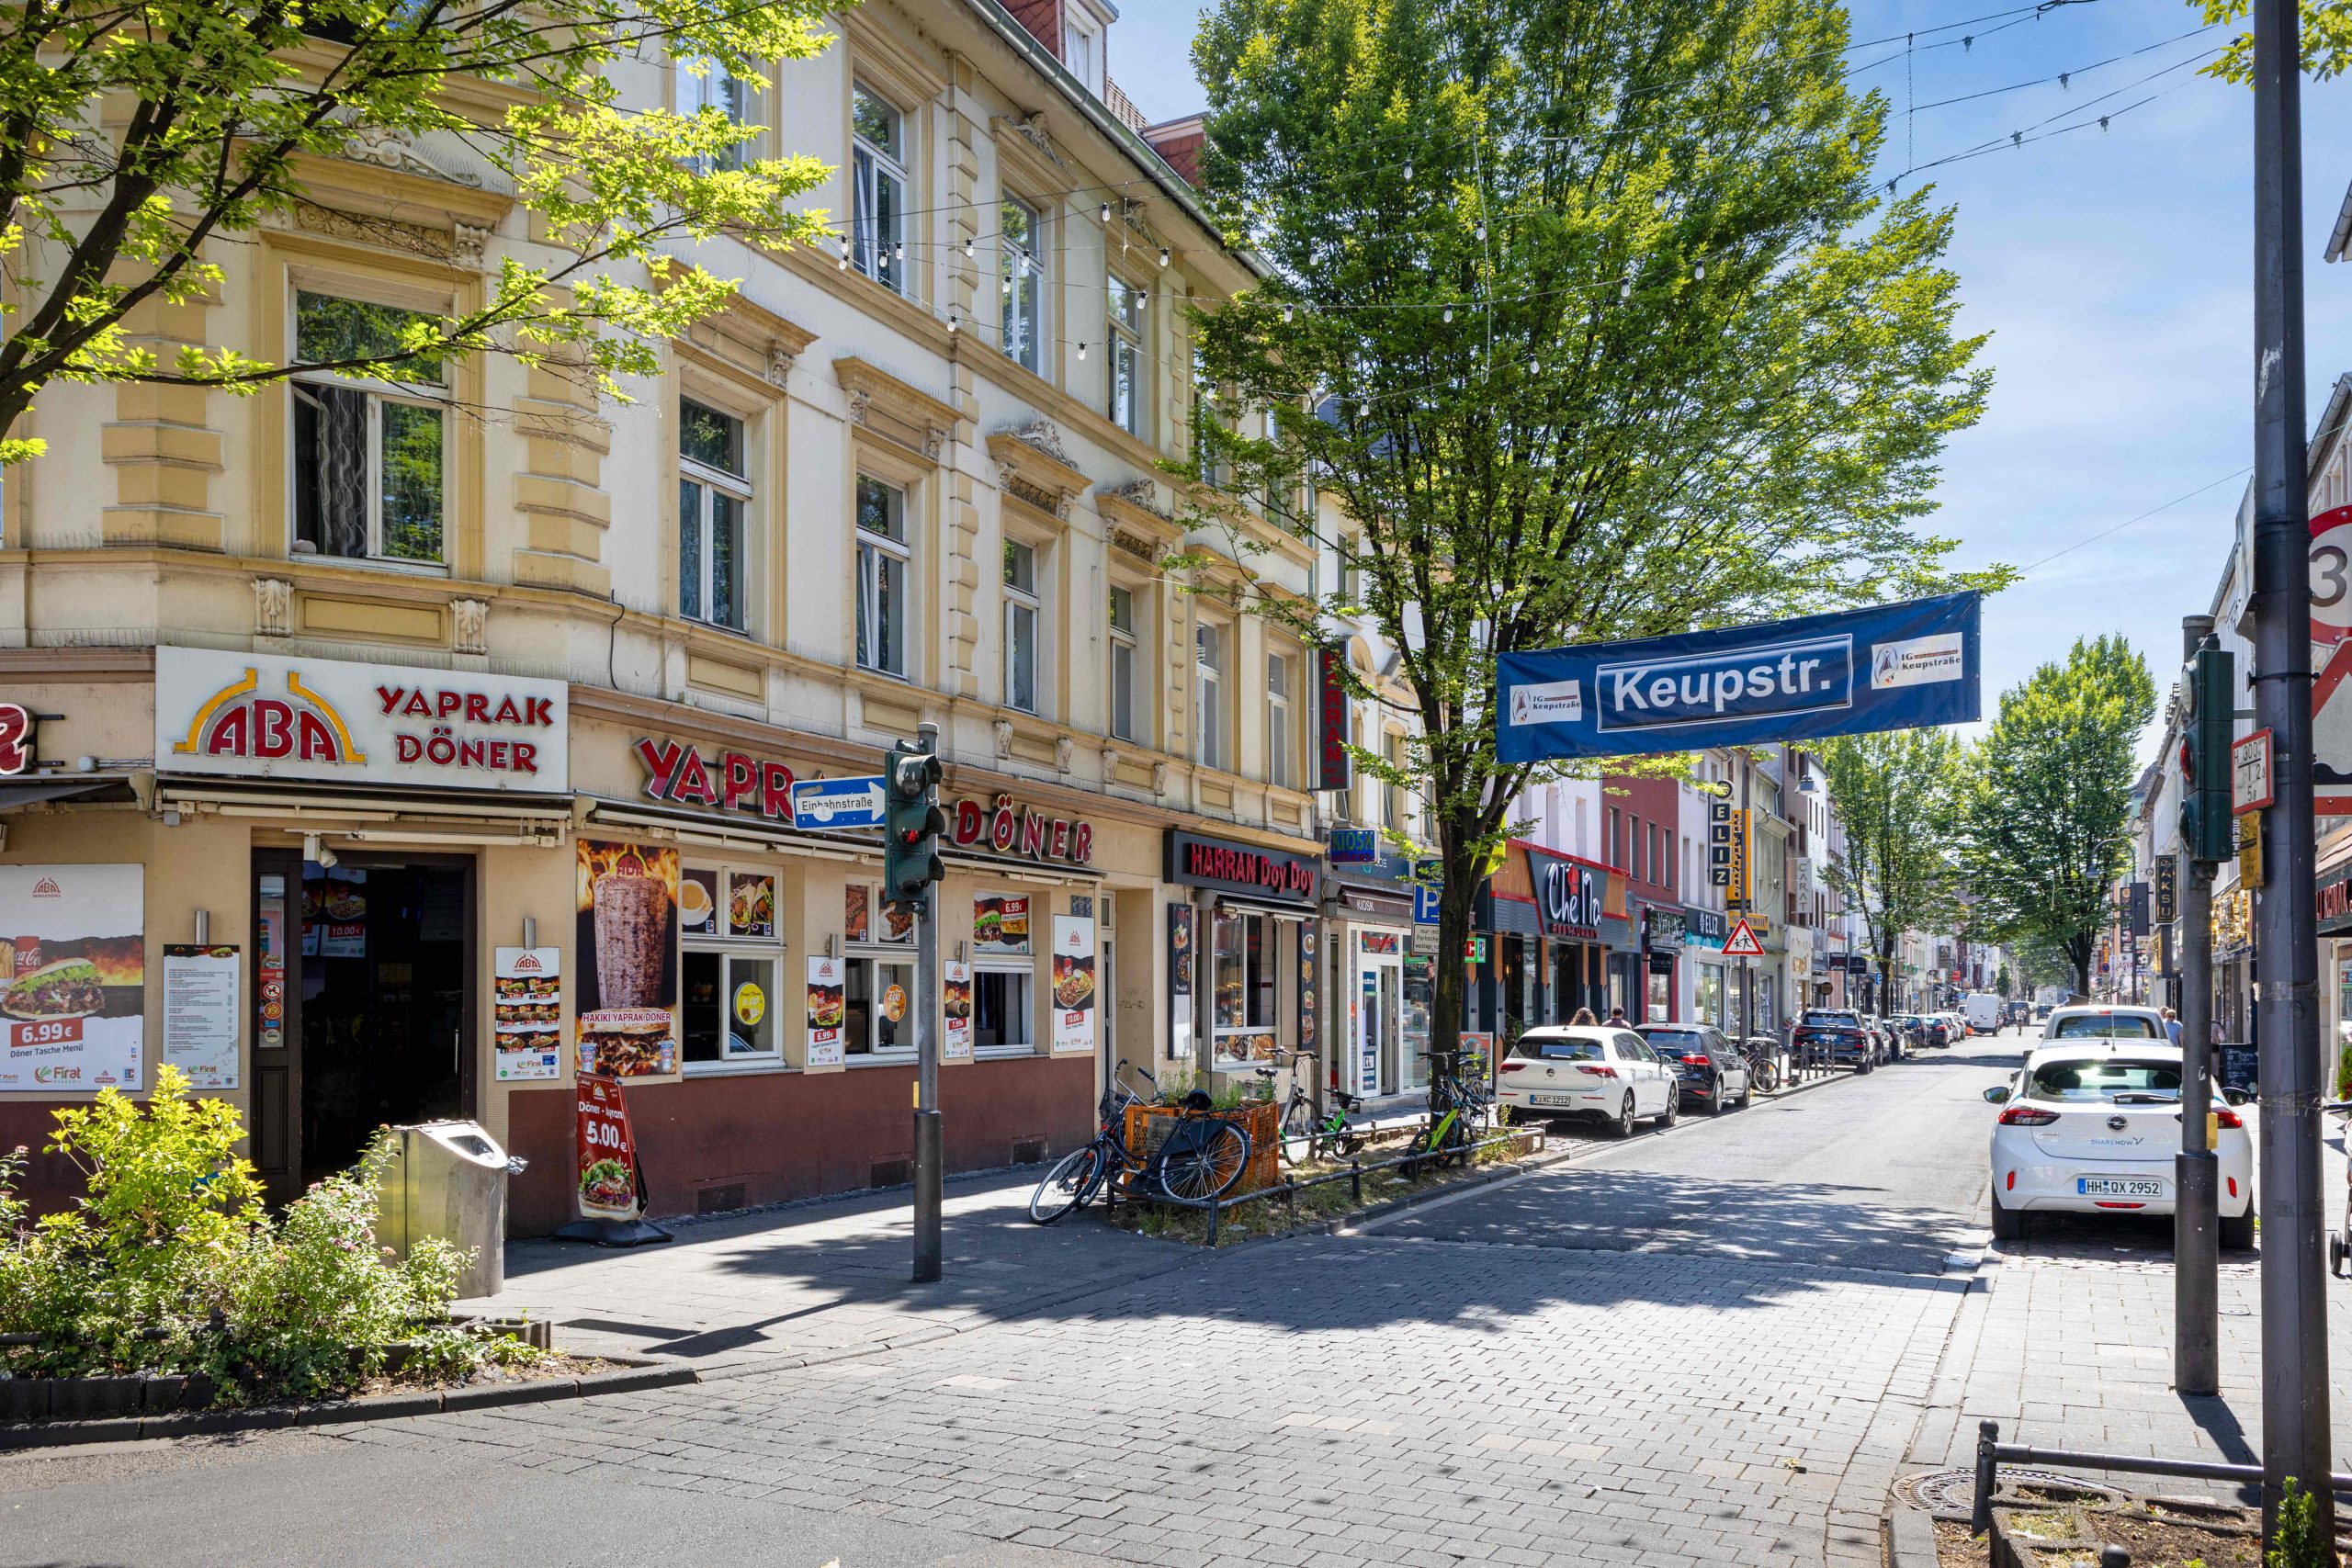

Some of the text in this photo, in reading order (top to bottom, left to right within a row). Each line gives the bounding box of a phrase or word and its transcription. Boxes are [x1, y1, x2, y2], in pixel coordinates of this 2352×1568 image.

[1901, 652, 1914, 660] IG
[1902, 656, 1962, 671] Keupstraße
[1613, 653, 1831, 713] Keupstr.
[376, 685, 554, 728] YAPRAK
[1532, 701, 1581, 711] Keupstraße
[206, 698, 338, 763] ABA
[396, 727, 539, 775] DÖNER
[636, 737, 1092, 863] YAPR DÖNER
[1332, 830, 1374, 852] KIOSK
[1716, 806, 1726, 884] ELIZ
[1189, 842, 1315, 897] HARRAN Doy Doy
[38, 882, 56, 894] ABA
[1798, 862, 1808, 912] CARAT
[1356, 899, 1375, 912] KIOSK
[518, 958, 538, 968] ABA
[613, 1013, 644, 1022] YAPRAK
[10, 1043, 84, 1058] Döner Tasche Menü
[586, 1120, 620, 1149] 5.00
[2086, 1181, 2159, 1194] HH QX 2952
